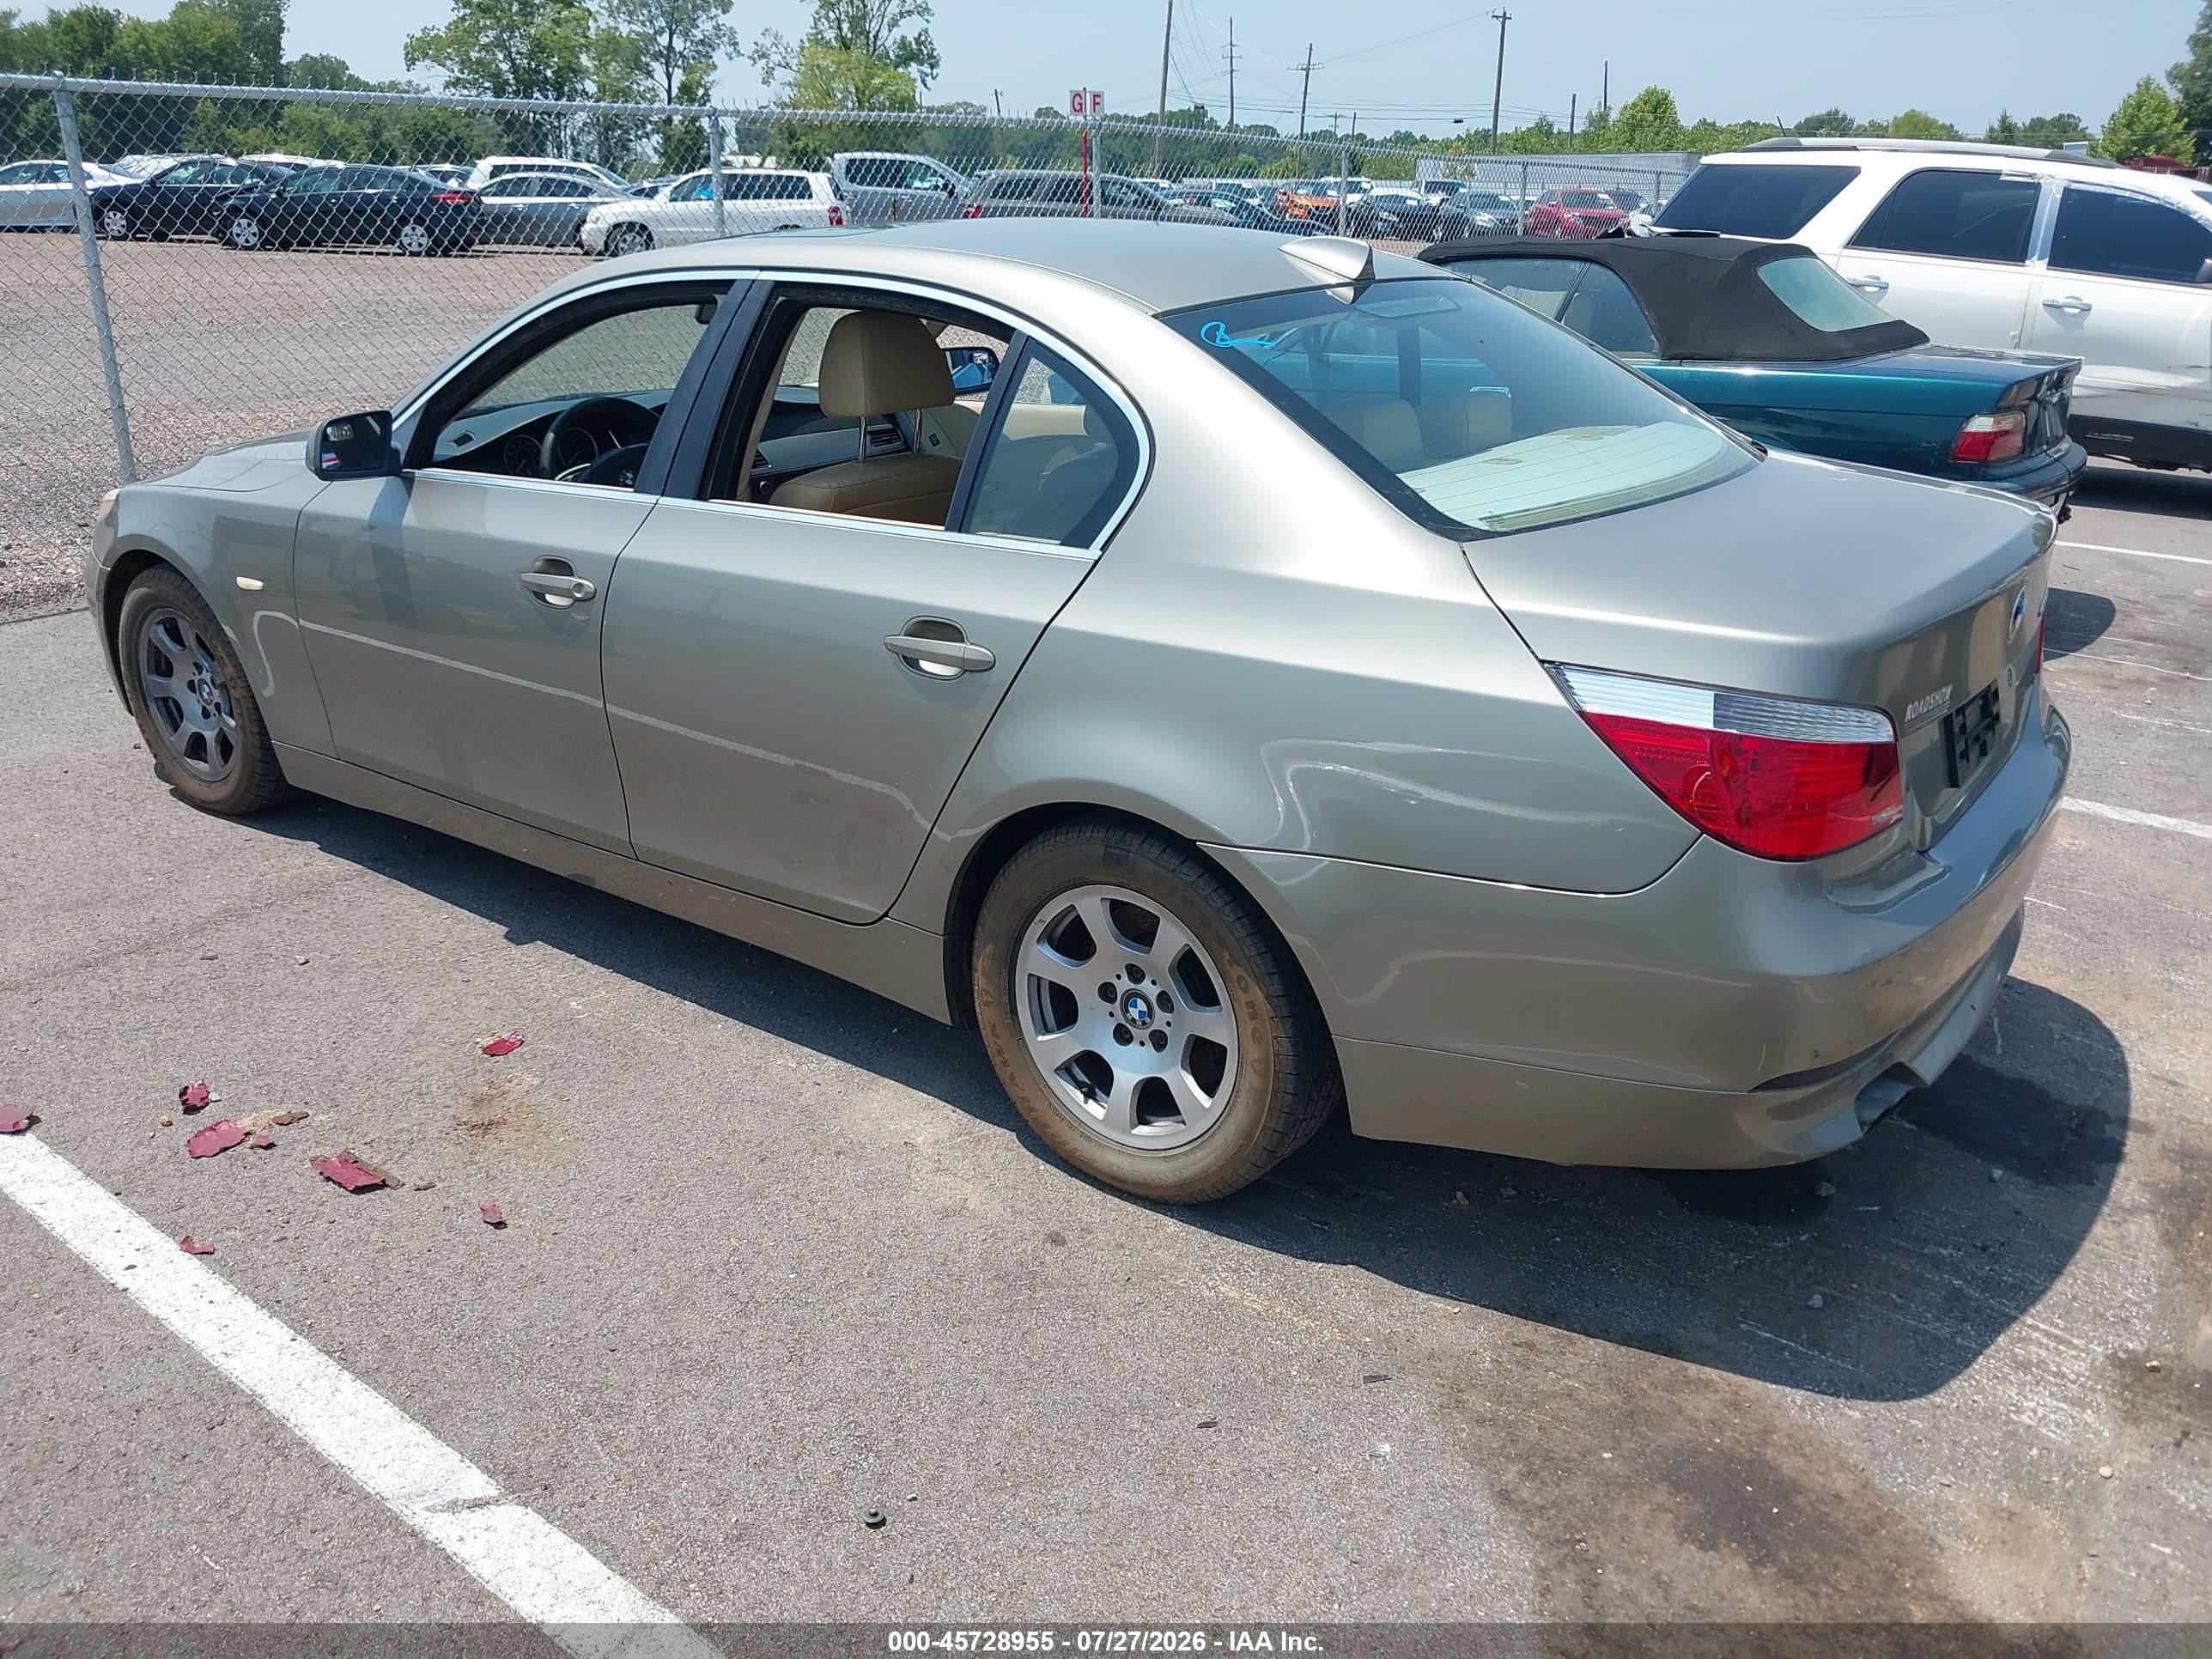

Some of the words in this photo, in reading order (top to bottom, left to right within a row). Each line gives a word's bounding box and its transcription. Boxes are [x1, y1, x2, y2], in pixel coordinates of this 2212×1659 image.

[1072, 93, 1084, 113] G
[1093, 94, 1101, 113] F
[1126, 1012, 1152, 1027] BMW
